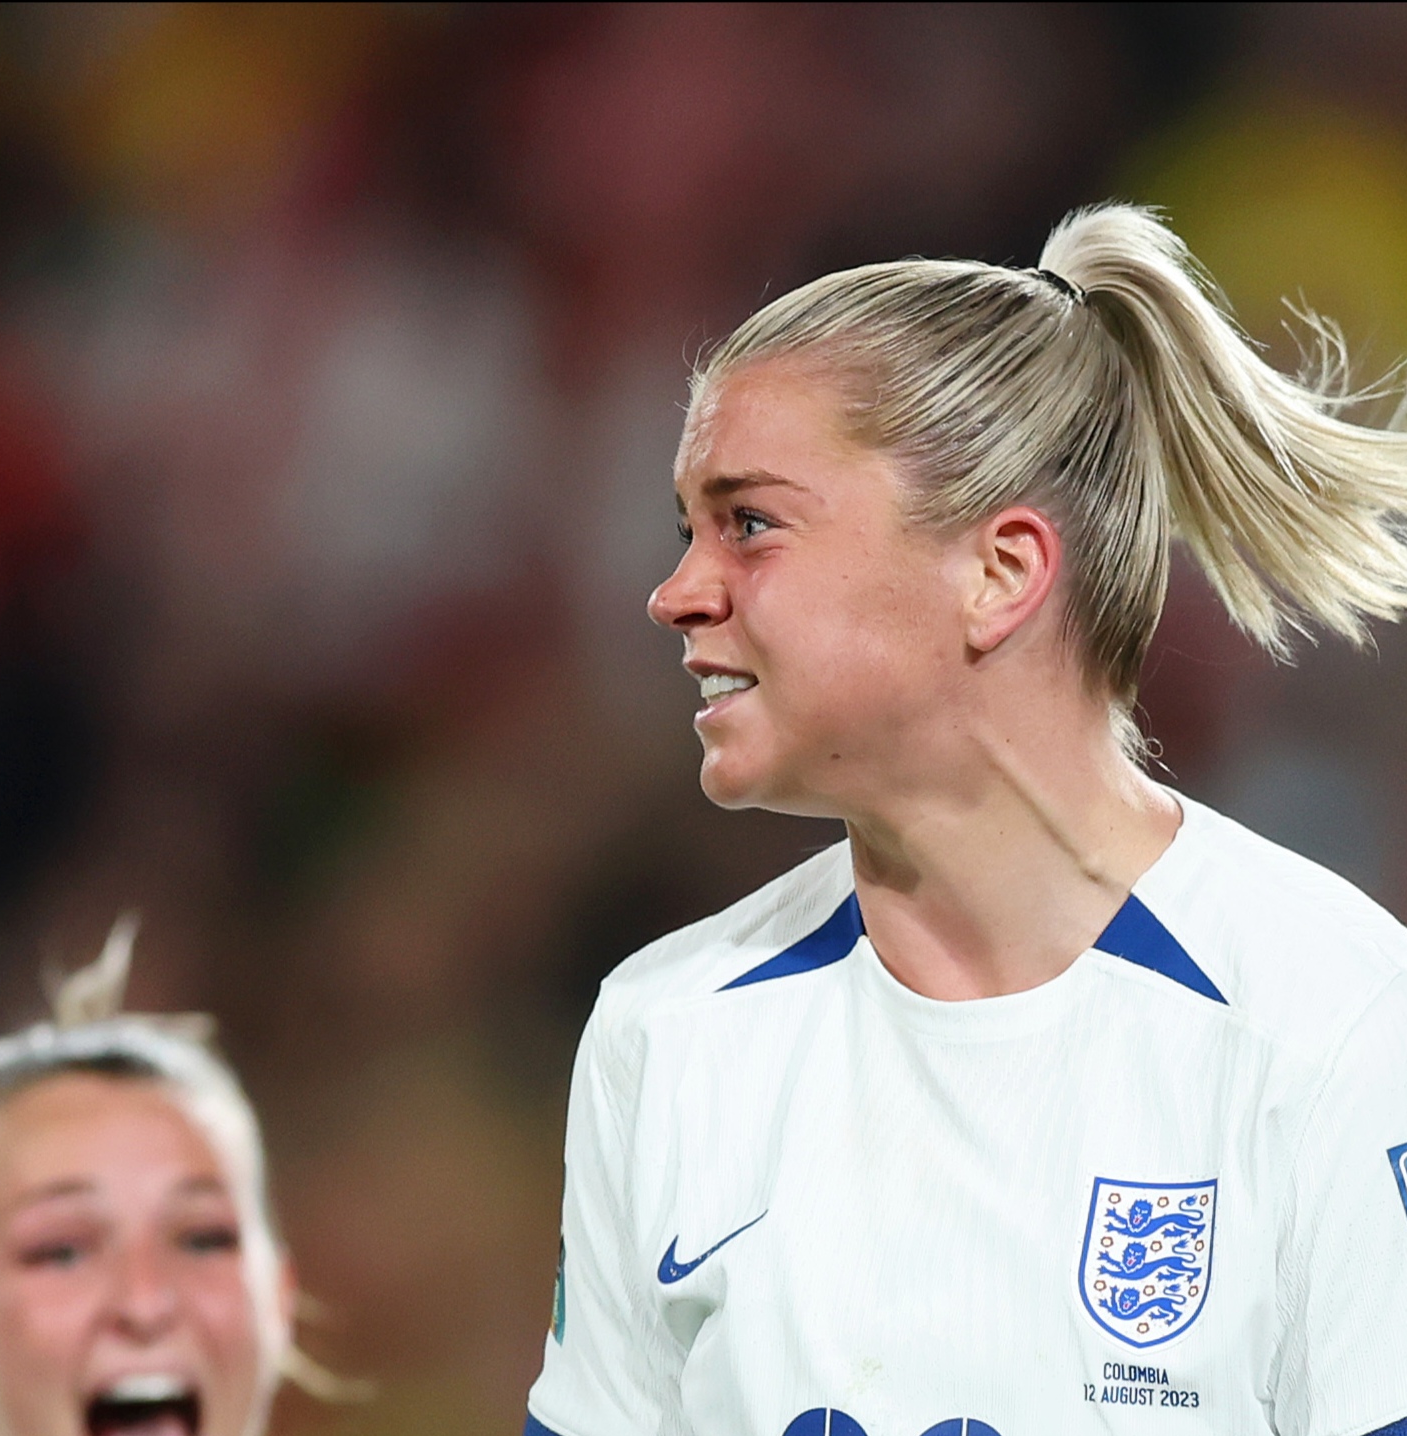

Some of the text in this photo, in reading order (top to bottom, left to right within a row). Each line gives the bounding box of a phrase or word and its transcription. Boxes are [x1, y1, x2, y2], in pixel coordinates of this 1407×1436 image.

[1103, 1362, 1170, 1386] COLOMBIA
[1083, 1383, 1200, 1408] 12 AUGUST 2023
